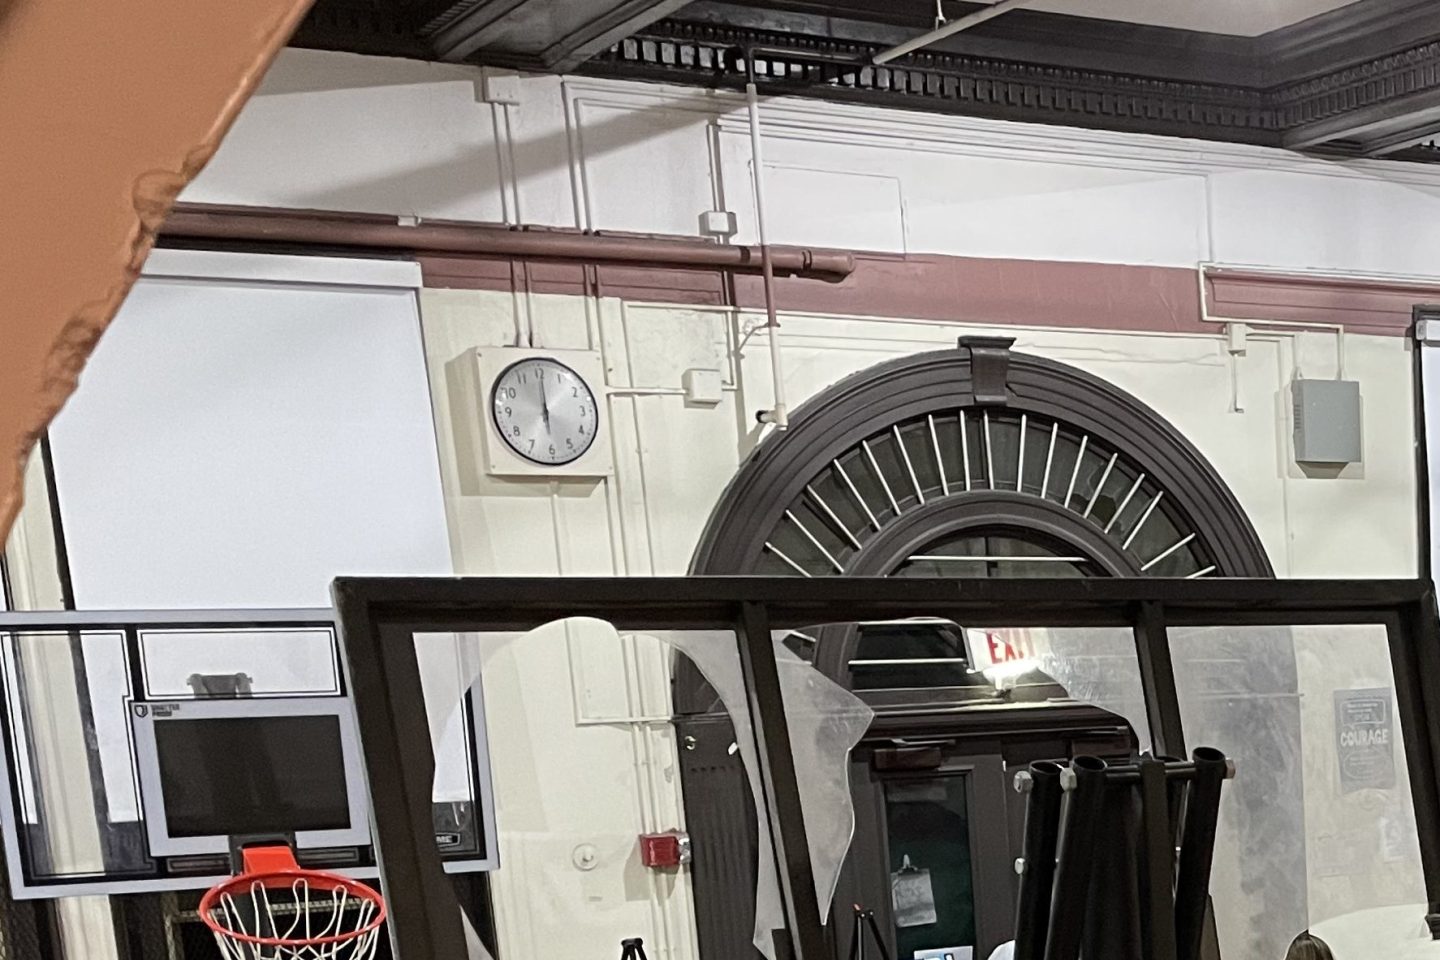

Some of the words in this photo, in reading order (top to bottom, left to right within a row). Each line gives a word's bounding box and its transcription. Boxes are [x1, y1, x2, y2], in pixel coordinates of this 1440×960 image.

[516, 374, 527, 385] 11
[535, 368, 545, 380] 12
[503, 387, 516, 399] 10
[572, 387, 578, 398] 2
[504, 407, 512, 418] 9
[580, 406, 586, 417] 3
[513, 425, 521, 437] 8
[578, 424, 585, 435] 4
[528, 439, 535, 451] 7
[549, 444, 556, 455] 6
[565, 438, 574, 450] 5
[1340, 729, 1388, 746] COURAGE
